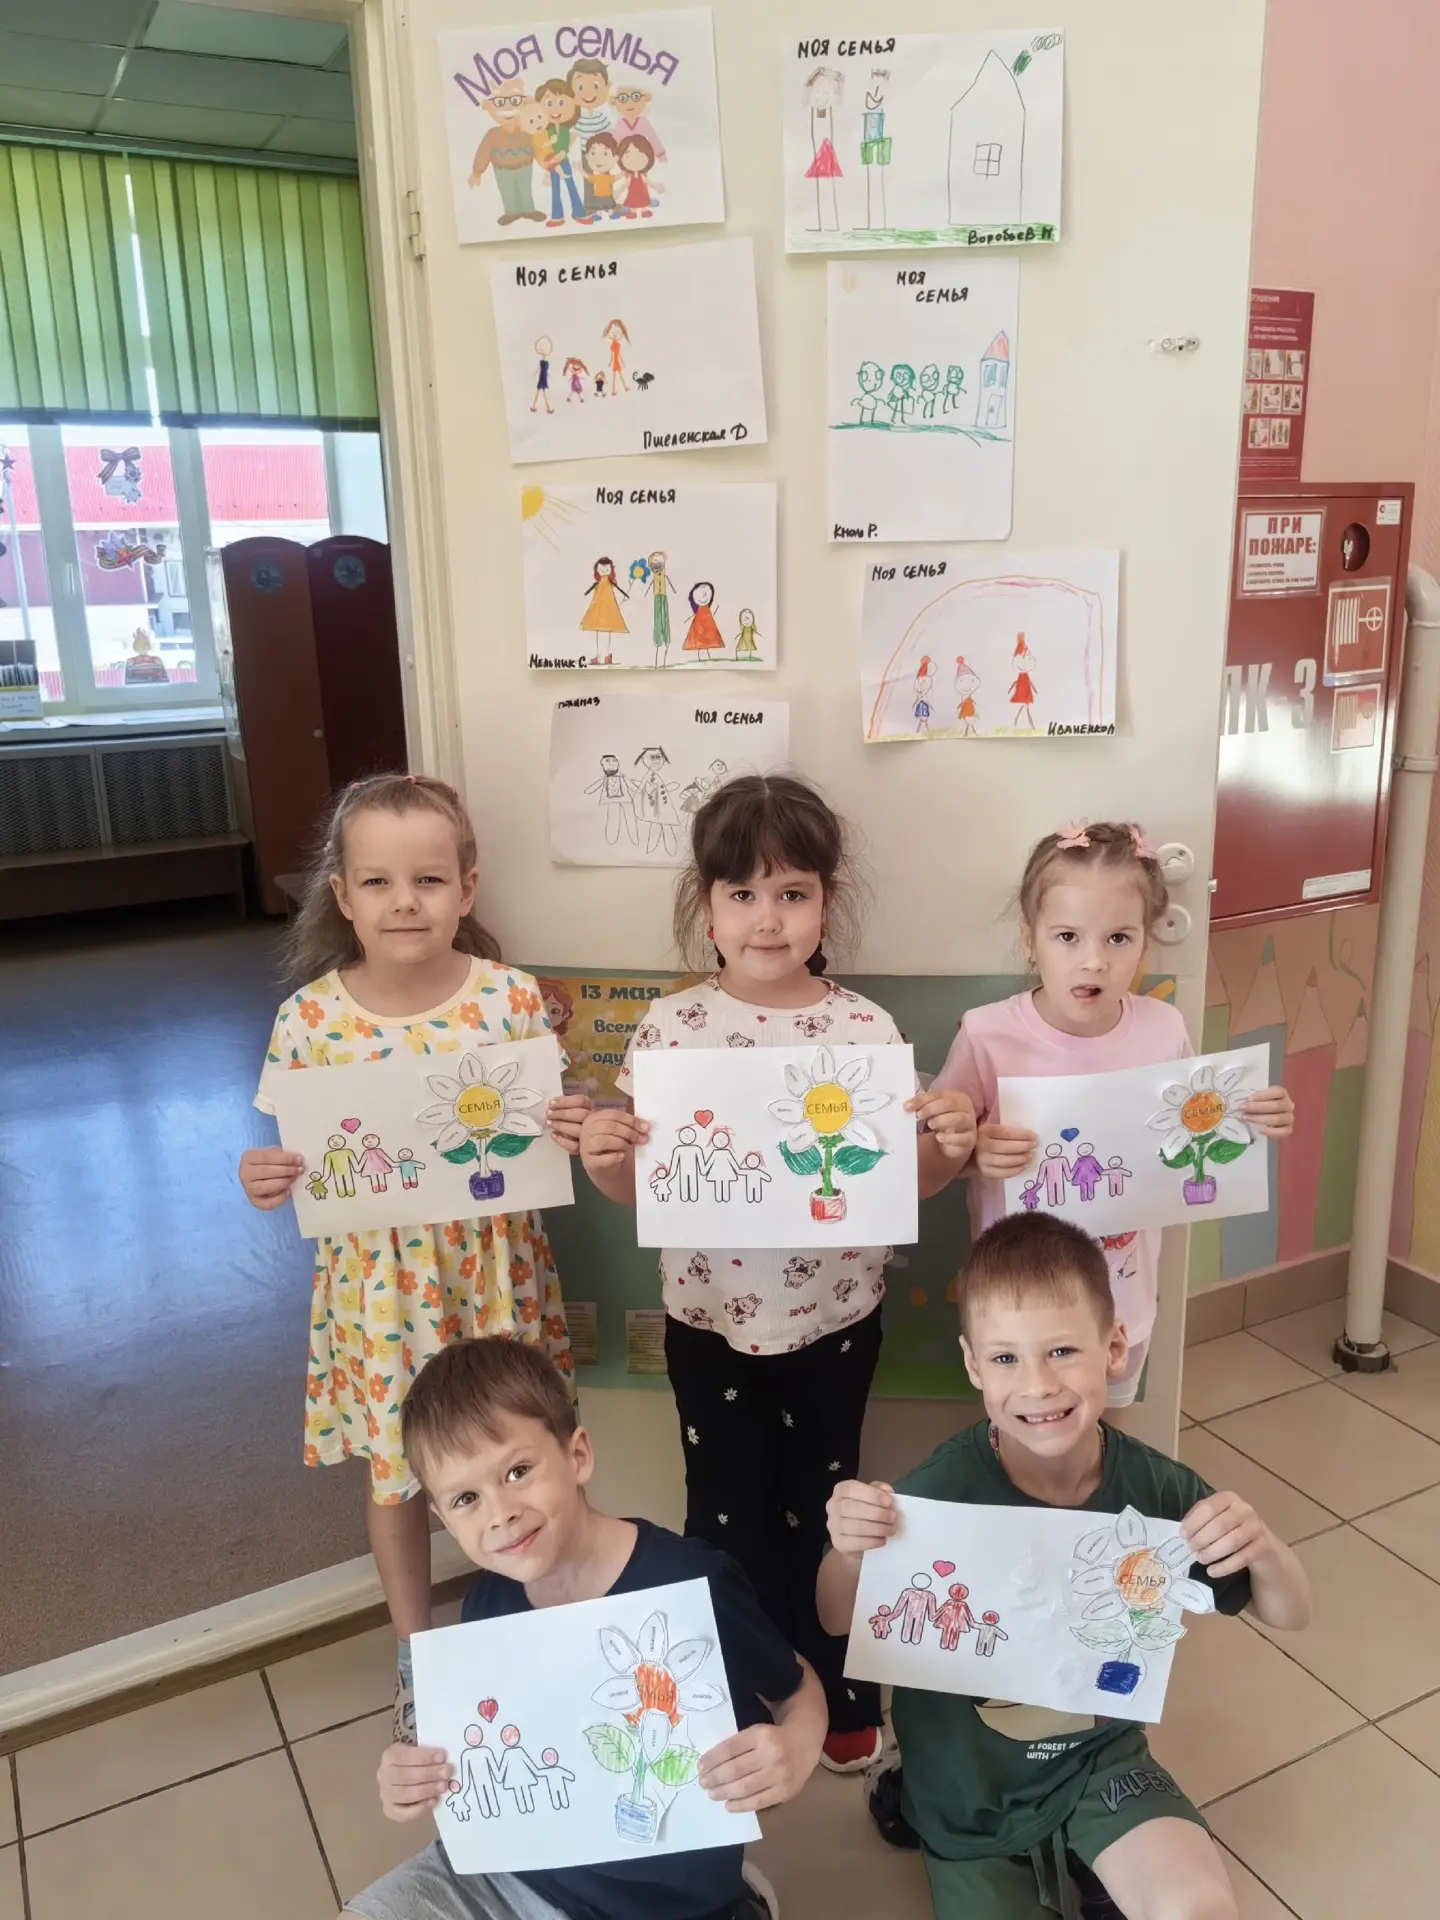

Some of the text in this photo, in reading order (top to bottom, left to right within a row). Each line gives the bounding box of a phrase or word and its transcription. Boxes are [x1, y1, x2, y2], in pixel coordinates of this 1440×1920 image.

[837, 38, 896, 56] СЕМЬЯ
[453, 25, 680, 107] Моя семья
[558, 261, 618, 283] СЕМЬЯ
[915, 286, 969, 303] СЕМЬЯ
[730, 422, 748, 440] Д
[630, 488, 676, 504] СЕМЬЯ
[1267, 516, 1302, 534] ПРИ
[1249, 536, 1316, 556] ПОЖАРЕ:
[903, 561, 947, 579] СЕМЬЯ
[724, 711, 764, 725] СЕМЬЯ
[581, 984, 661, 1000] 13 мая
[458, 1099, 501, 1114] СЕМЬЯ
[806, 1102, 848, 1115] СЕМЬЯ
[1119, 1574, 1167, 1588] СЕМЬЯ
[1037, 1742, 1067, 1751] FOREST
[1026, 1751, 1049, 1760] WITH
